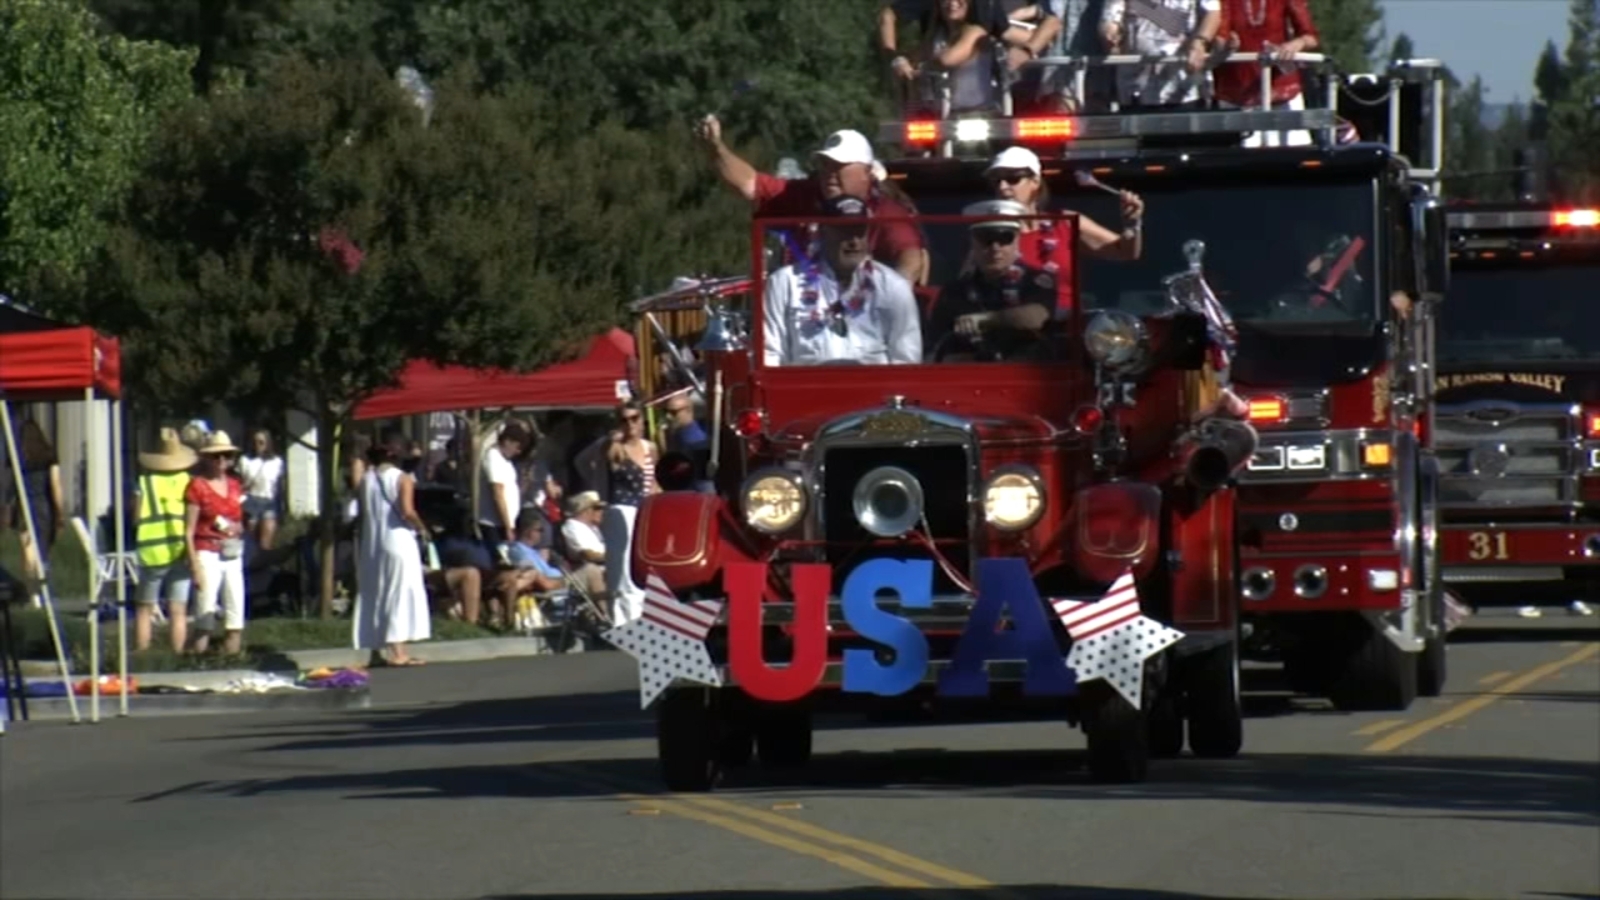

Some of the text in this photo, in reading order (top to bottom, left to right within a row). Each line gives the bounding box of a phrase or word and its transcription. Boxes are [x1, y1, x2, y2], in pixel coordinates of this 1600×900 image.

[1509, 373, 1565, 393] VALLEY
[1469, 532, 1509, 560] 31
[723, 557, 1078, 701] USA
